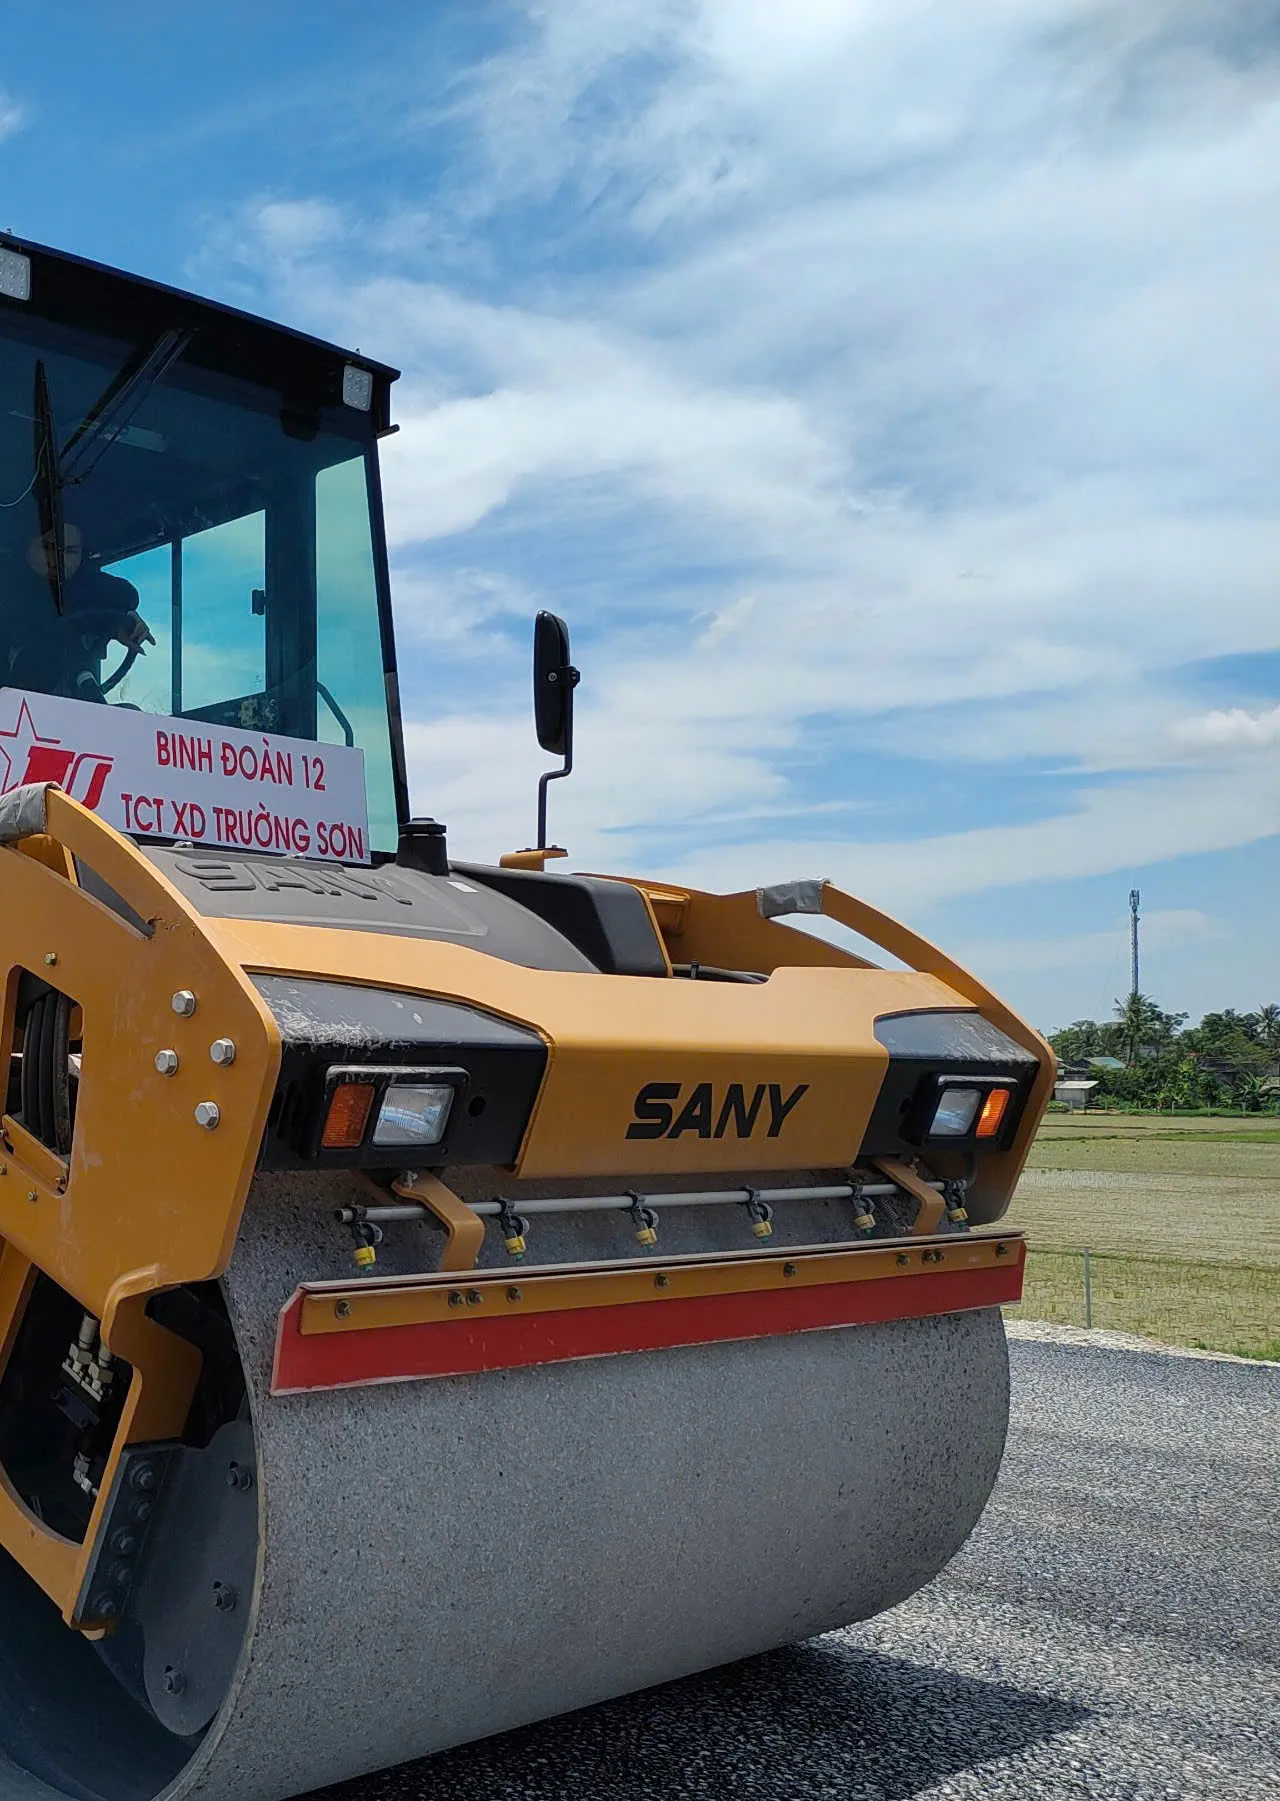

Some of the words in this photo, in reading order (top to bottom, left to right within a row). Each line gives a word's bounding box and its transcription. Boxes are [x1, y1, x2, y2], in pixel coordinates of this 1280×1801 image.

[156, 730, 213, 774] BINH
[220, 736, 294, 786] ĐOÀN
[301, 754, 326, 792] 12
[121, 793, 164, 833] TCT
[171, 800, 207, 839] XD
[212, 801, 311, 853] TRƯỜNG
[316, 821, 364, 861] SƠN
[624, 1082, 811, 1140] SANY
